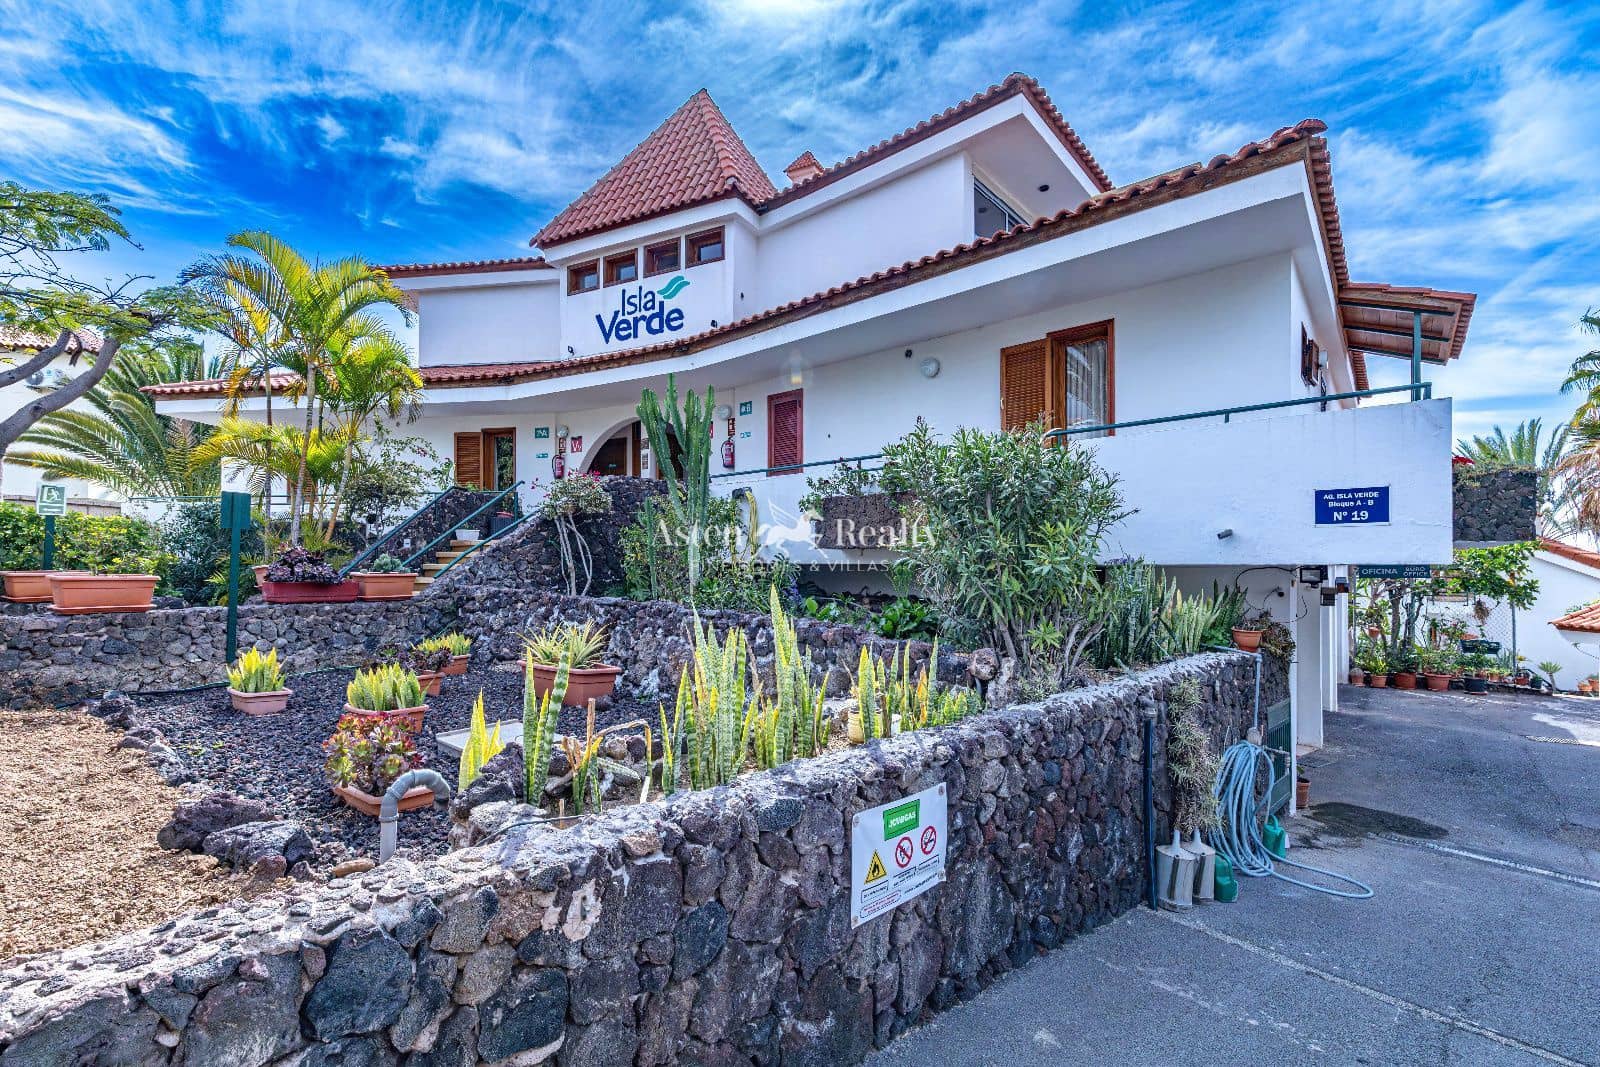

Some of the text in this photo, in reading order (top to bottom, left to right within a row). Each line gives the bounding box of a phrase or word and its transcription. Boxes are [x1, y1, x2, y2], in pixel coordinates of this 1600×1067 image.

[621, 285, 656, 316] Isla
[595, 300, 685, 345] Verde
[1351, 510, 1369, 521] 19
